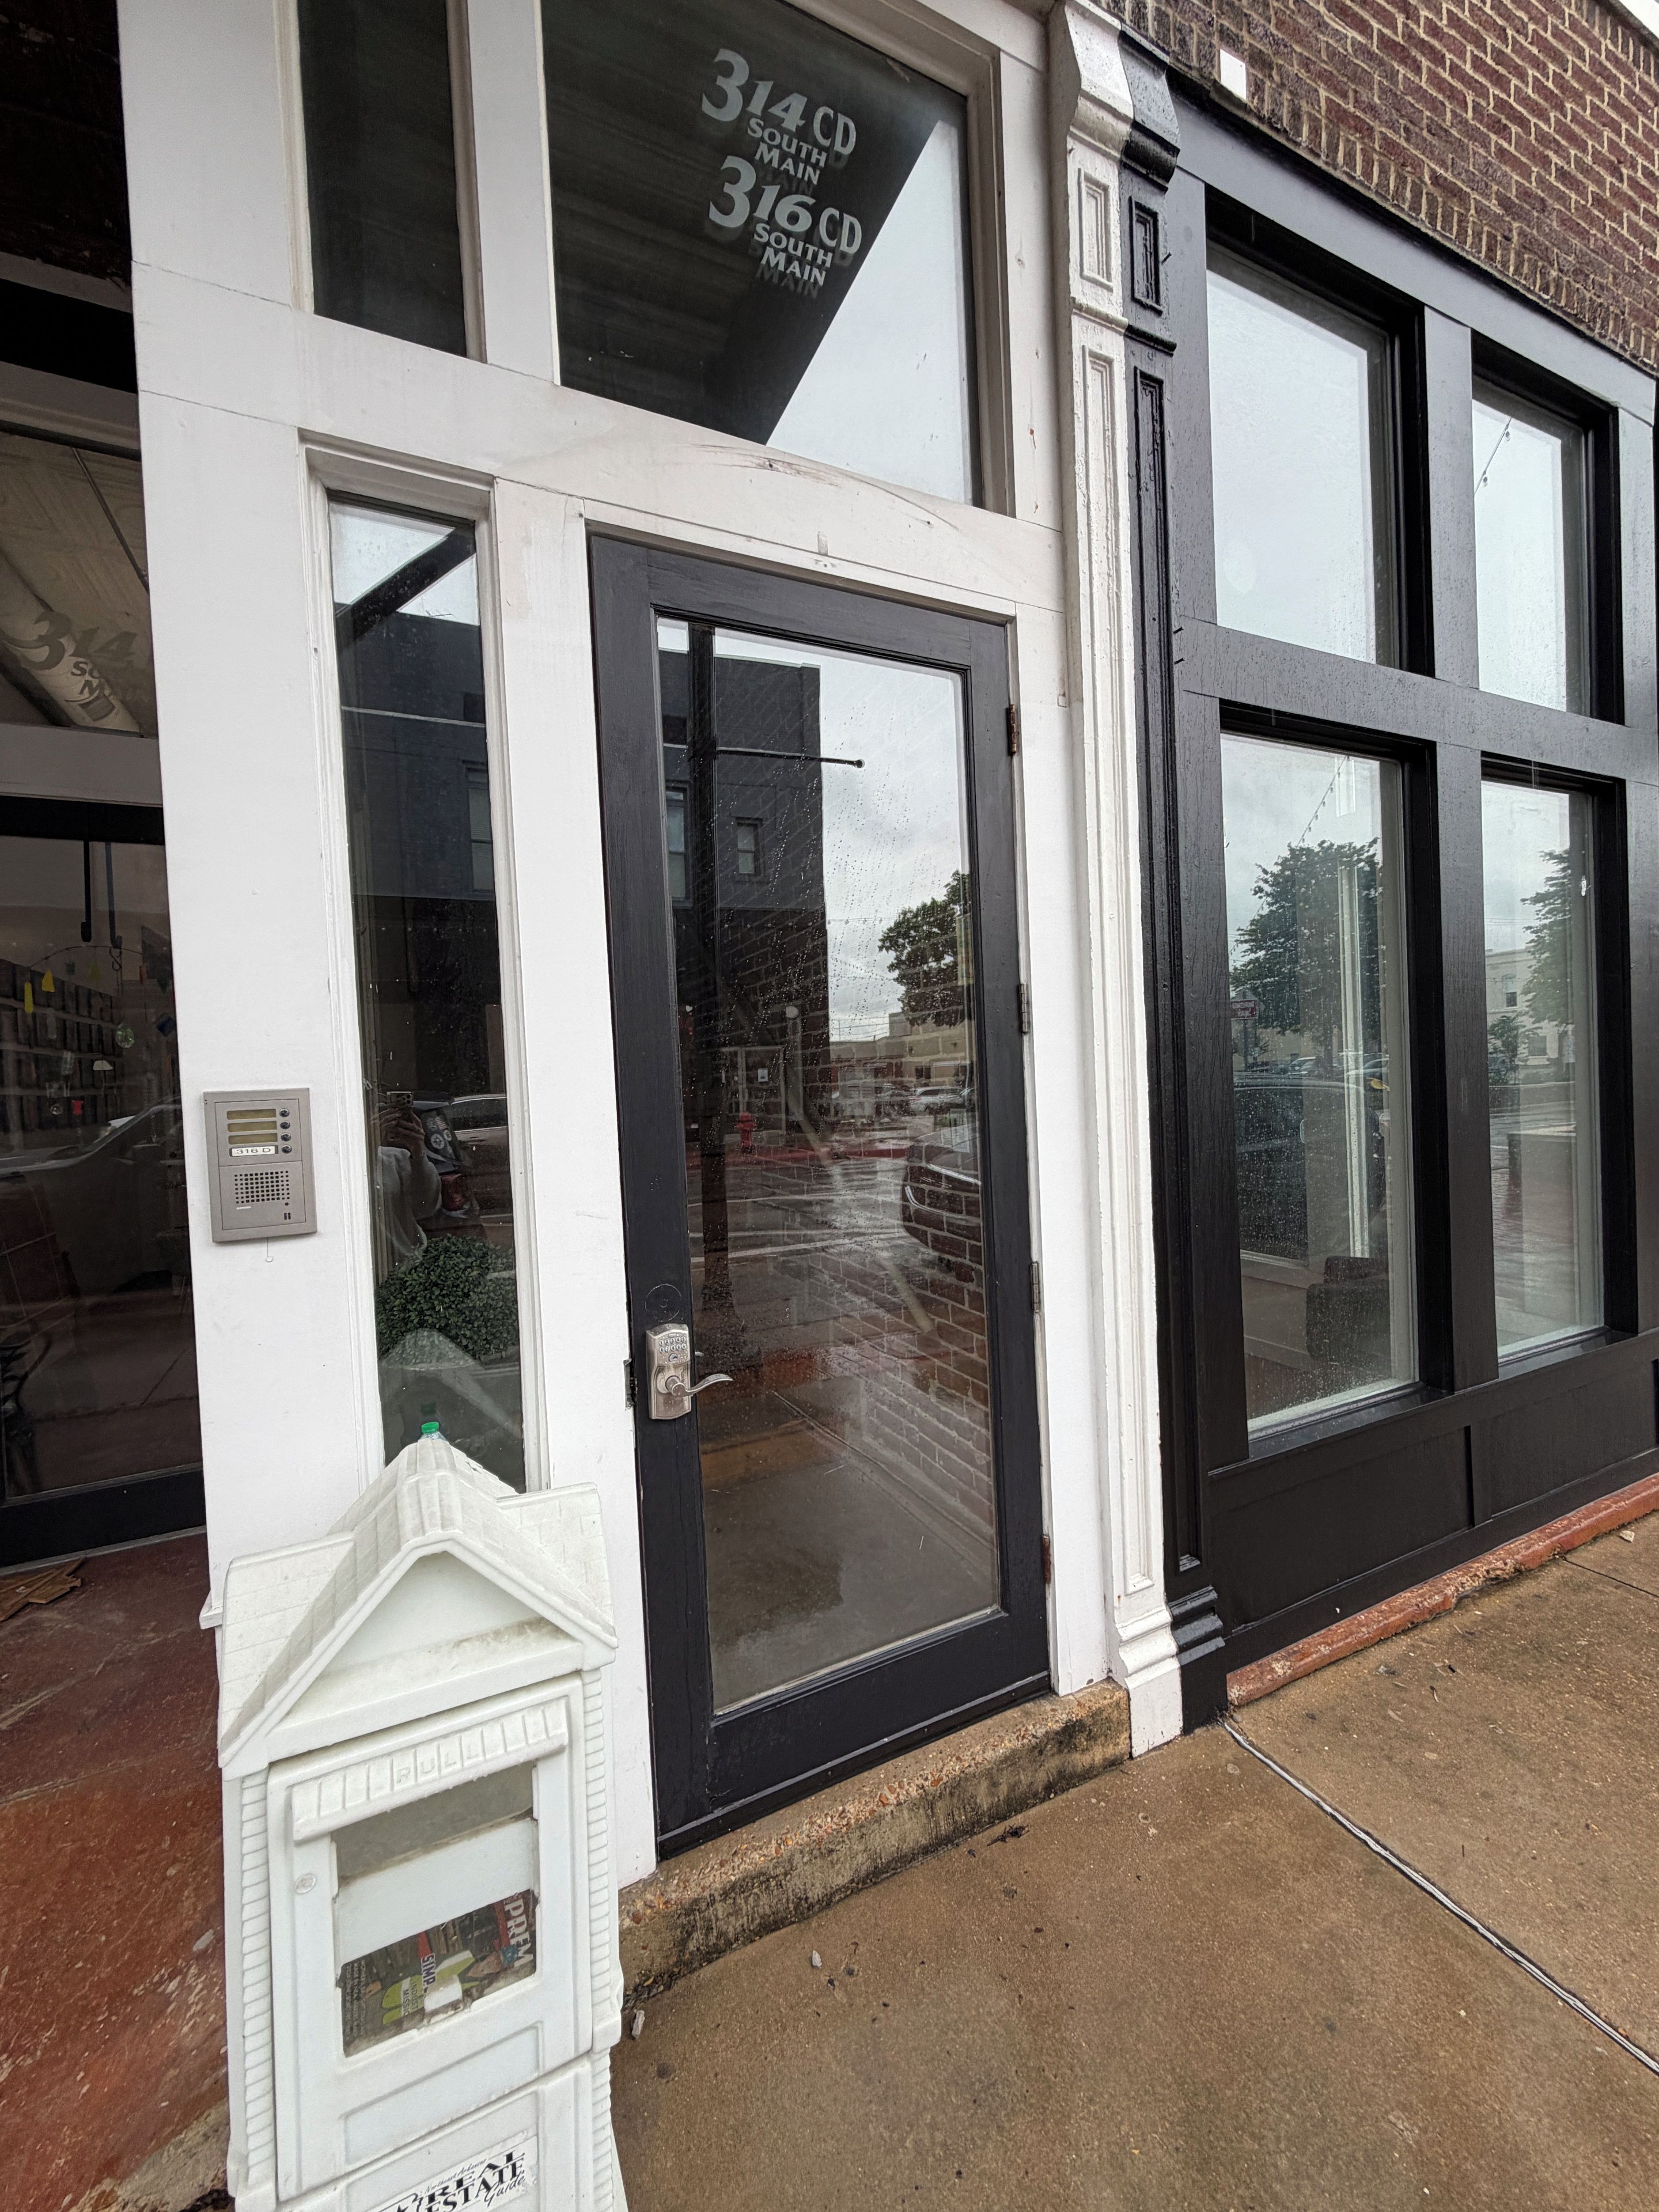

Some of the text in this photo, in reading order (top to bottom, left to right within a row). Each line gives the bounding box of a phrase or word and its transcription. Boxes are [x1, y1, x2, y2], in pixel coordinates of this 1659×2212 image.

[702, 48, 857, 155] 314 CD
[747, 118, 827, 167] SOUTH
[754, 141, 820, 185] MAIN
[709, 155, 862, 253] 316 CD
[753, 222, 833, 268] SOUTH
[760, 246, 827, 286] MAIN
[425, 2150, 525, 2205] REAL
[484, 2169, 526, 2208] Guide
